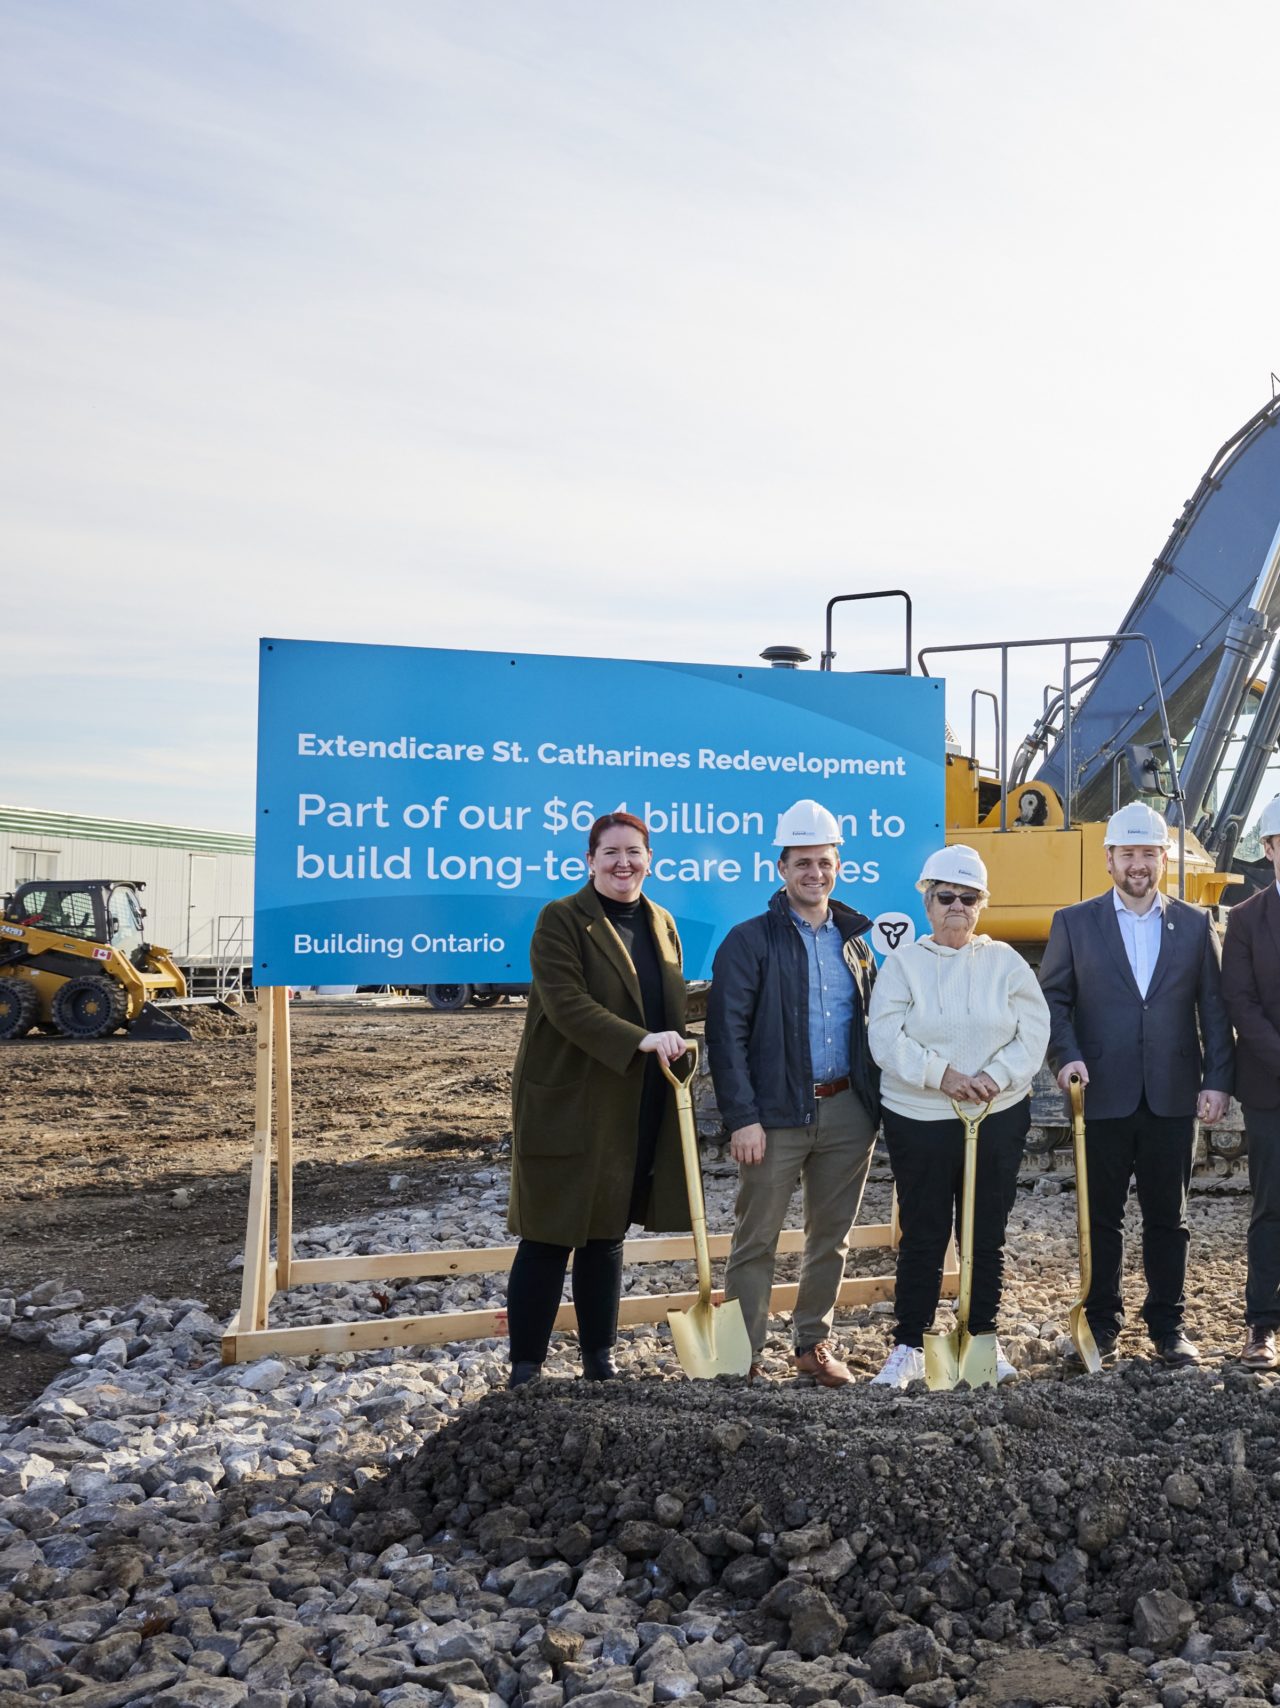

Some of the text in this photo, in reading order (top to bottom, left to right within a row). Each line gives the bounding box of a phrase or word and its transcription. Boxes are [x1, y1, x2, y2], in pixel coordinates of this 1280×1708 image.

[298, 733, 906, 779] Extendicare St. Catharines Redevelopment
[298, 793, 390, 828] Part
[403, 795, 449, 829] of
[459, 805, 531, 830] our
[644, 801, 764, 835] billion
[869, 808, 906, 838] to
[296, 845, 880, 889] build long-te care hes
[294, 933, 505, 959] Building Ontario
